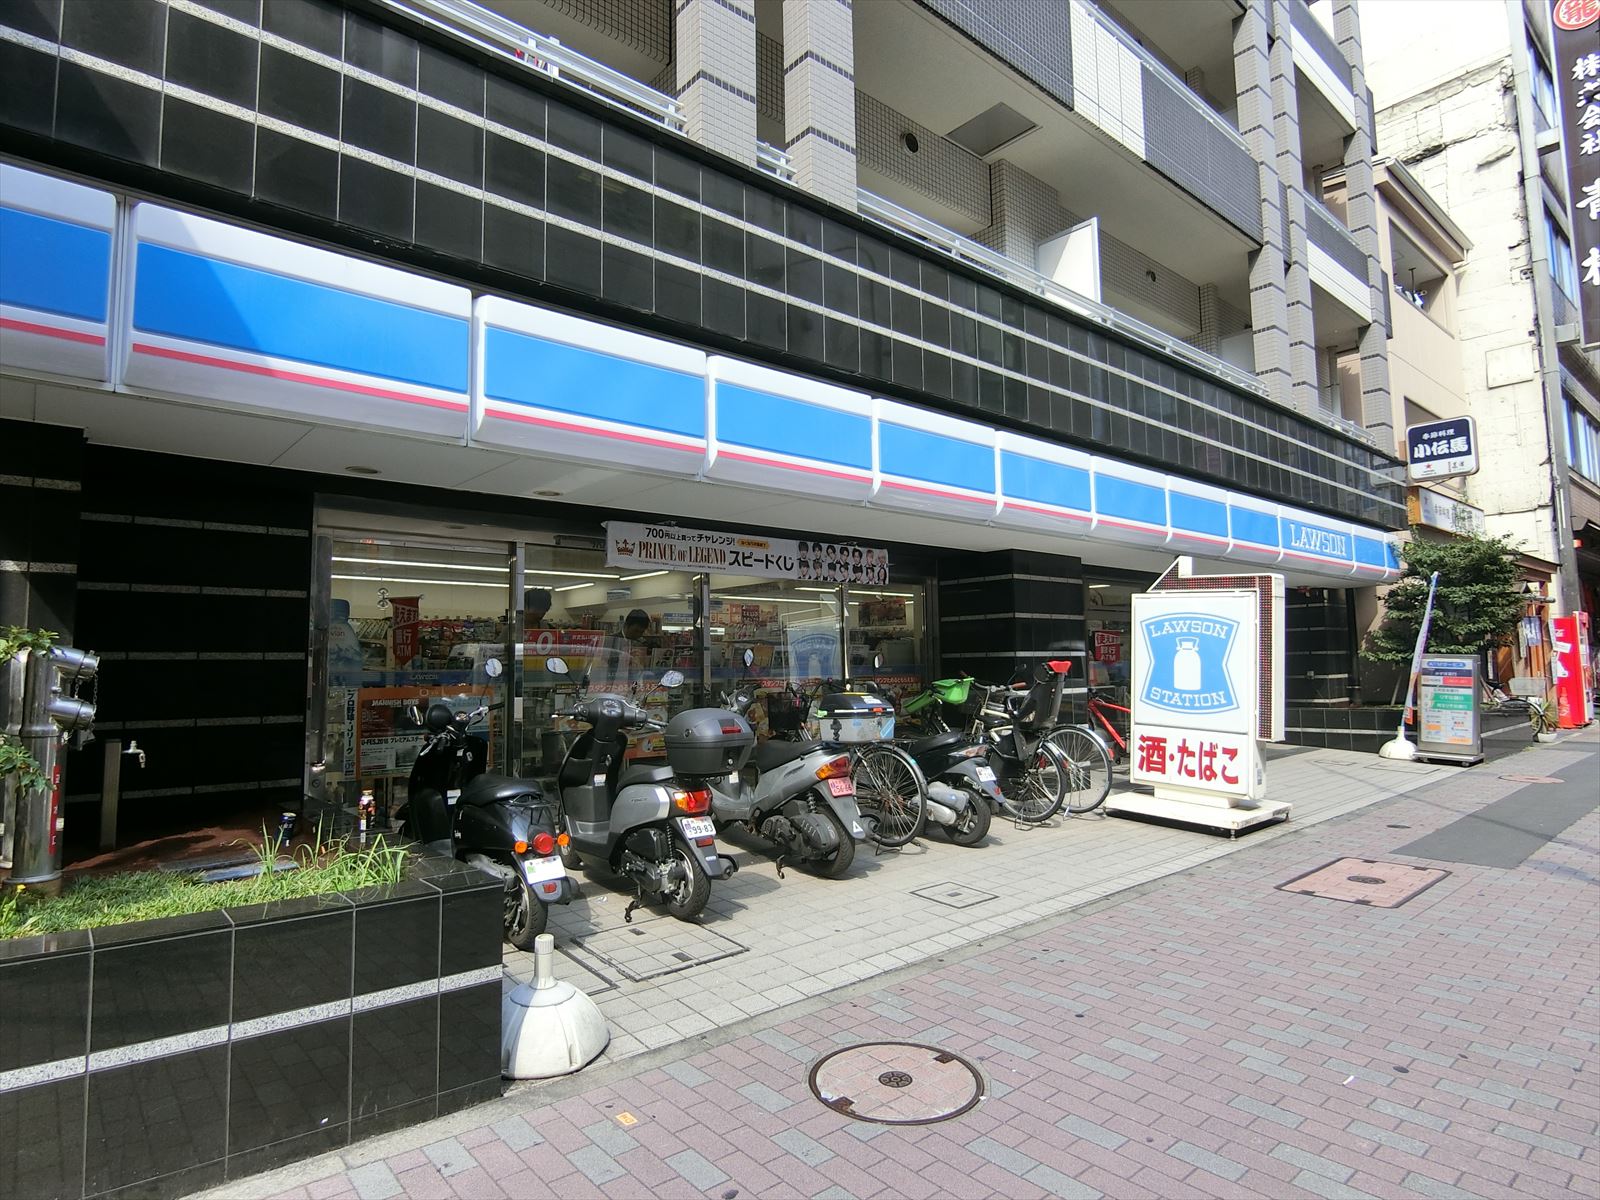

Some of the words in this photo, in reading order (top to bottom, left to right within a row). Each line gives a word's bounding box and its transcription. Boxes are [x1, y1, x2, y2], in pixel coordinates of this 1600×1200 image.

[1413, 436, 1469, 459] 小伝馬
[1290, 524, 1346, 556] LAWSON
[638, 540, 677, 561] PRINCE
[688, 546, 727, 565] LEGEND
[728, 550, 795, 571] スピードくじ
[1149, 620, 1229, 639] LAWSON
[1150, 686, 1228, 707] STATION
[1137, 733, 1239, 785] 酒・たばこ
